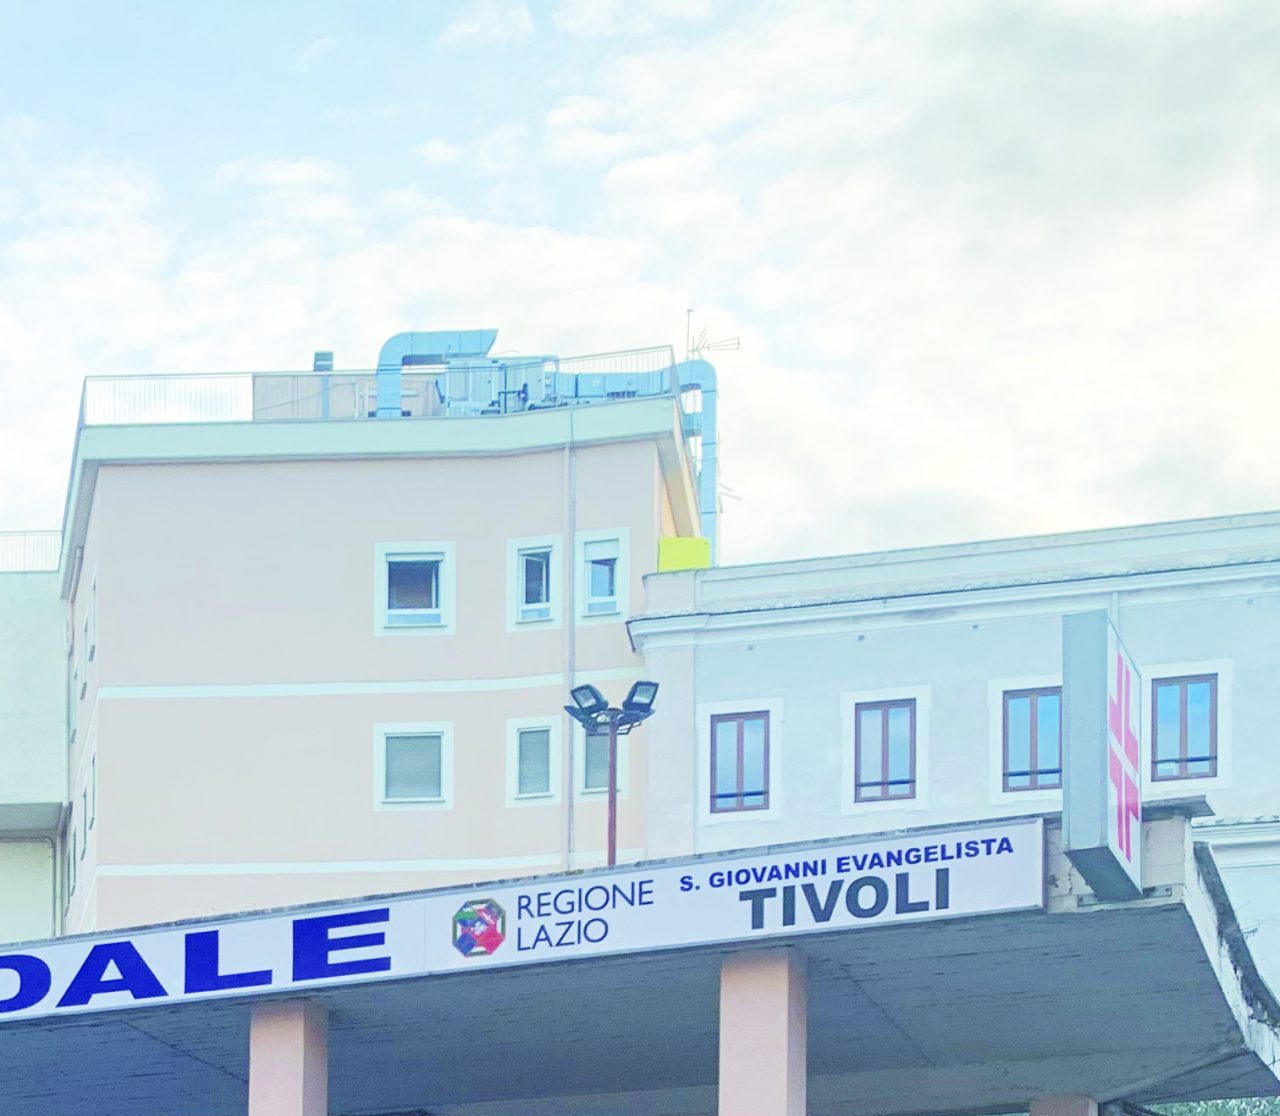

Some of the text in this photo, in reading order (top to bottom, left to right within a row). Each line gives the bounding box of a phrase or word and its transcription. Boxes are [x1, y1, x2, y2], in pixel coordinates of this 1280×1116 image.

[680, 837, 1014, 892] S. GIOVANNI EVANGELISTA
[517, 880, 654, 920] REGIONE
[739, 868, 950, 931] TIVOLI
[517, 918, 609, 952] LAZIO
